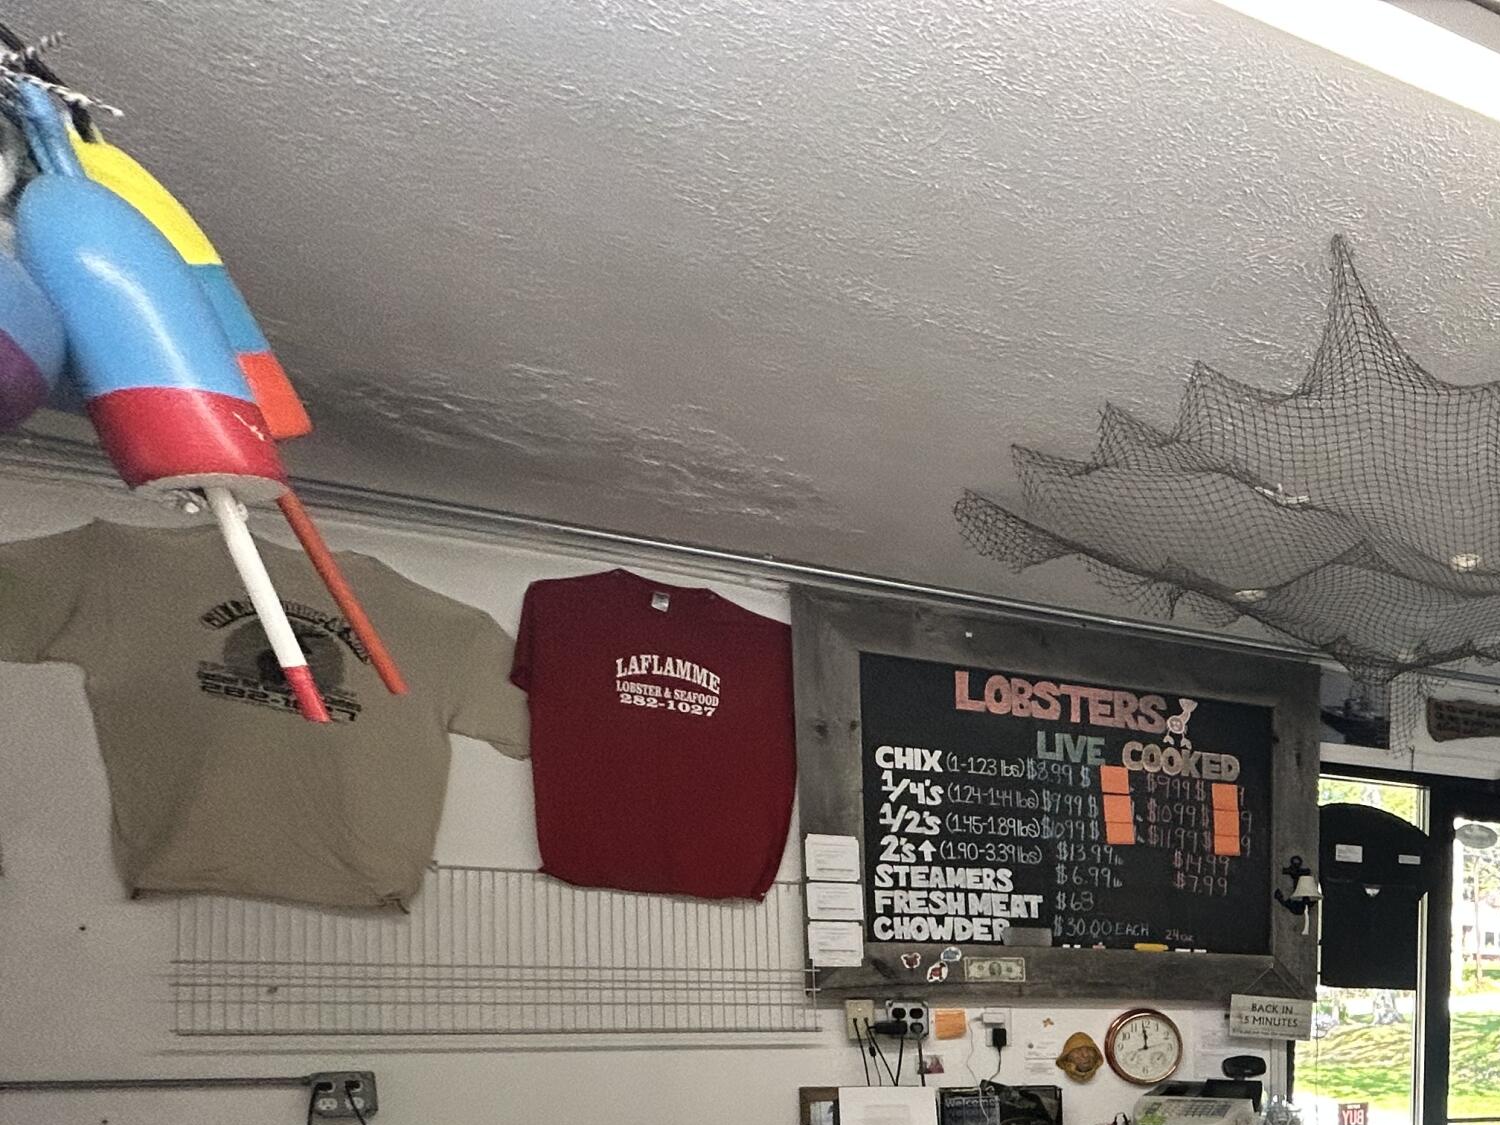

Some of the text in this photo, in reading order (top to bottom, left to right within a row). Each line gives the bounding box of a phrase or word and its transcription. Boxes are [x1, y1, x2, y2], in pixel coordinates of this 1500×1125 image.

[616, 654, 720, 695] LAFLAMME
[616, 680, 719, 707] LOBSTER & SEAFOOD
[620, 693, 716, 717] 282-1027
[954, 670, 1168, 734] LOBSTERS
[875, 746, 943, 773] CHIX
[1037, 731, 1240, 782] LIVE COOKED
[881, 770, 944, 806] 1/4's
[879, 803, 941, 835] 1/2's
[879, 835, 917, 863] 2's
[875, 864, 1014, 892] STEAMERS
[874, 889, 966, 916] FRESH
[968, 895, 1043, 918] MEAT
[874, 916, 1010, 942] CHOWDER
[1114, 922, 1149, 938] EACH
[1251, 1003, 1294, 1015] BACK IN
[1252, 1016, 1298, 1028] MINUTES
